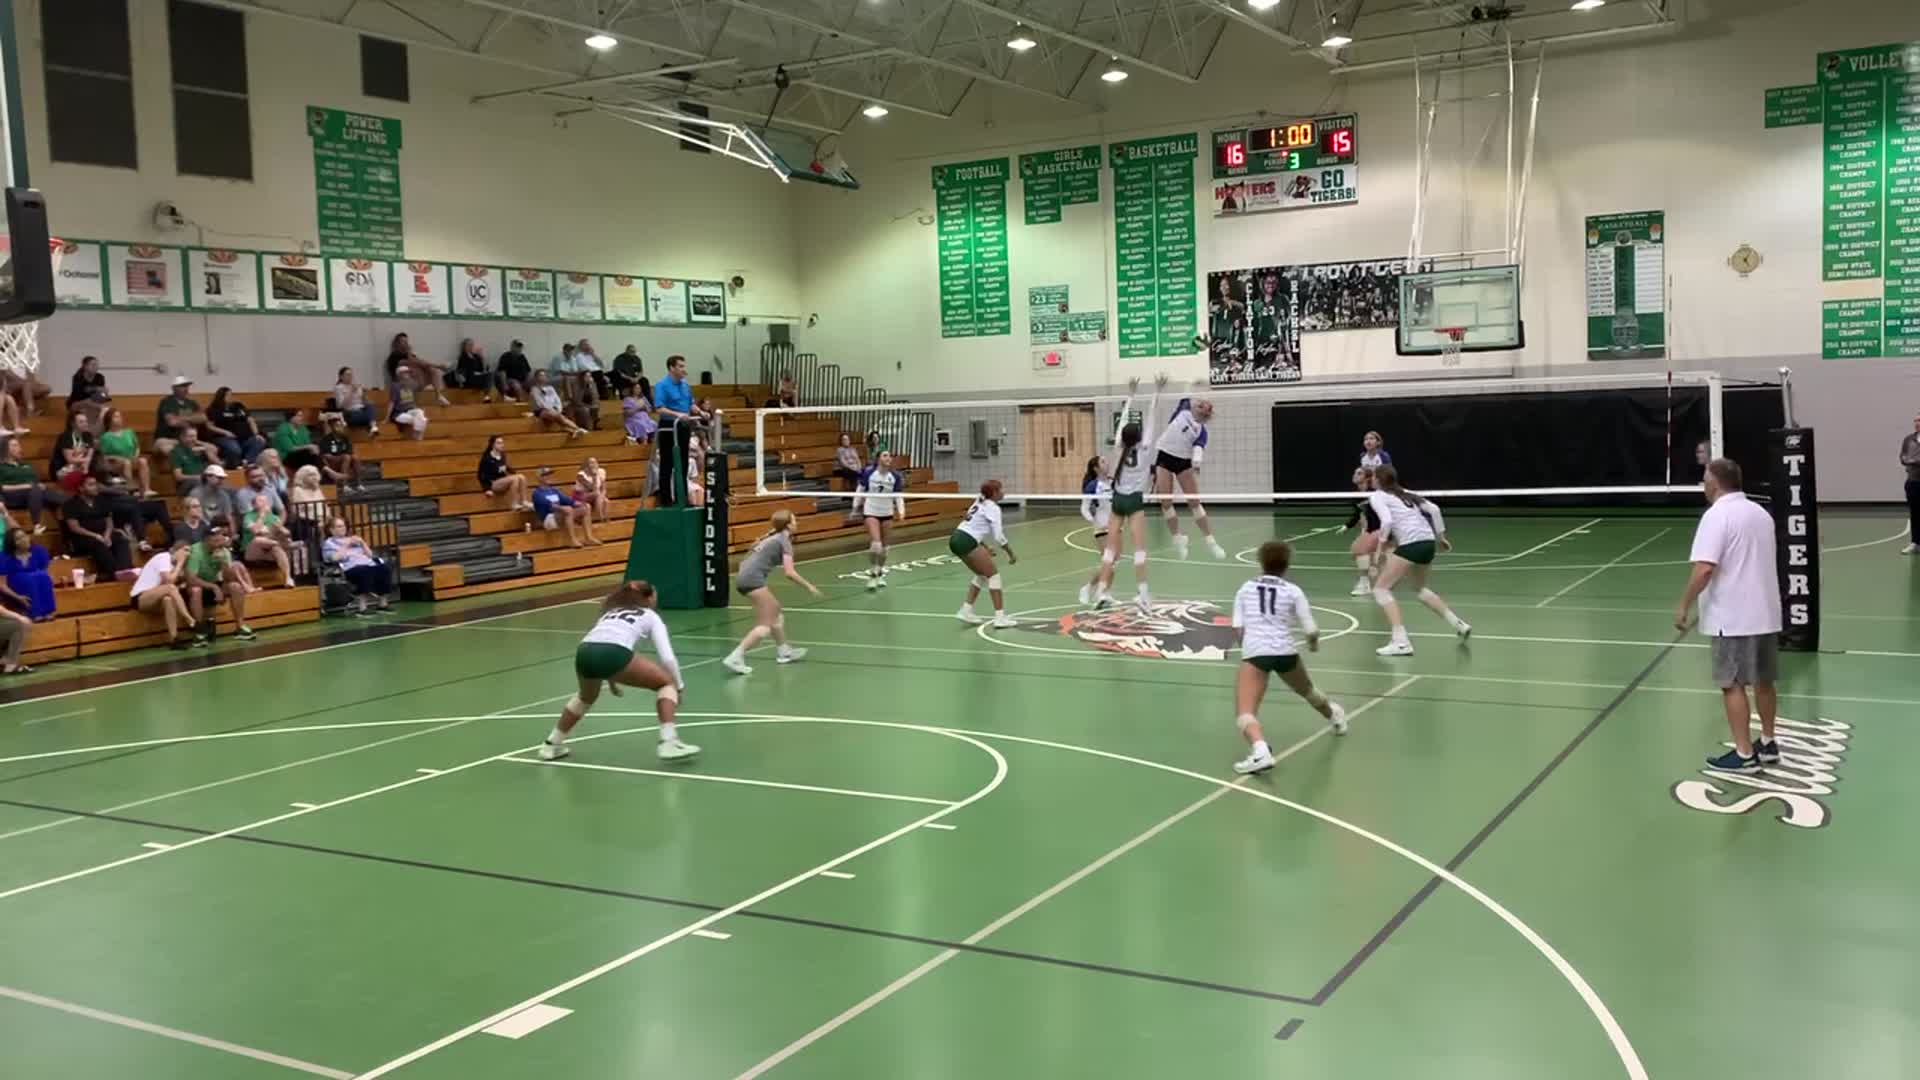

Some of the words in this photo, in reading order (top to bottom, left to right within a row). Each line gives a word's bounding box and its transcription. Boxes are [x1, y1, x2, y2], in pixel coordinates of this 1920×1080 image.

[1318, 118, 1353, 131] VISITOR
[1217, 132, 1241, 143] HOME
[1270, 124, 1312, 147] 1:00
[1333, 131, 1351, 153] 15
[1055, 149, 1083, 162] GIRLS
[1129, 139, 1197, 160] BASKETBALL
[1226, 143, 1243, 165] 16
[1037, 158, 1100, 175] BASKETBALL
[1289, 152, 1300, 169] 3
[956, 164, 1002, 180] FOOTBALL
[1321, 169, 1344, 189] GO
[1310, 187, 1356, 203] TIGERS!
[469, 284, 486, 299] UC
[705, 471, 716, 592] SLIDELL
[1783, 454, 1810, 625] TIGERS
[1256, 585, 1277, 615] 11
